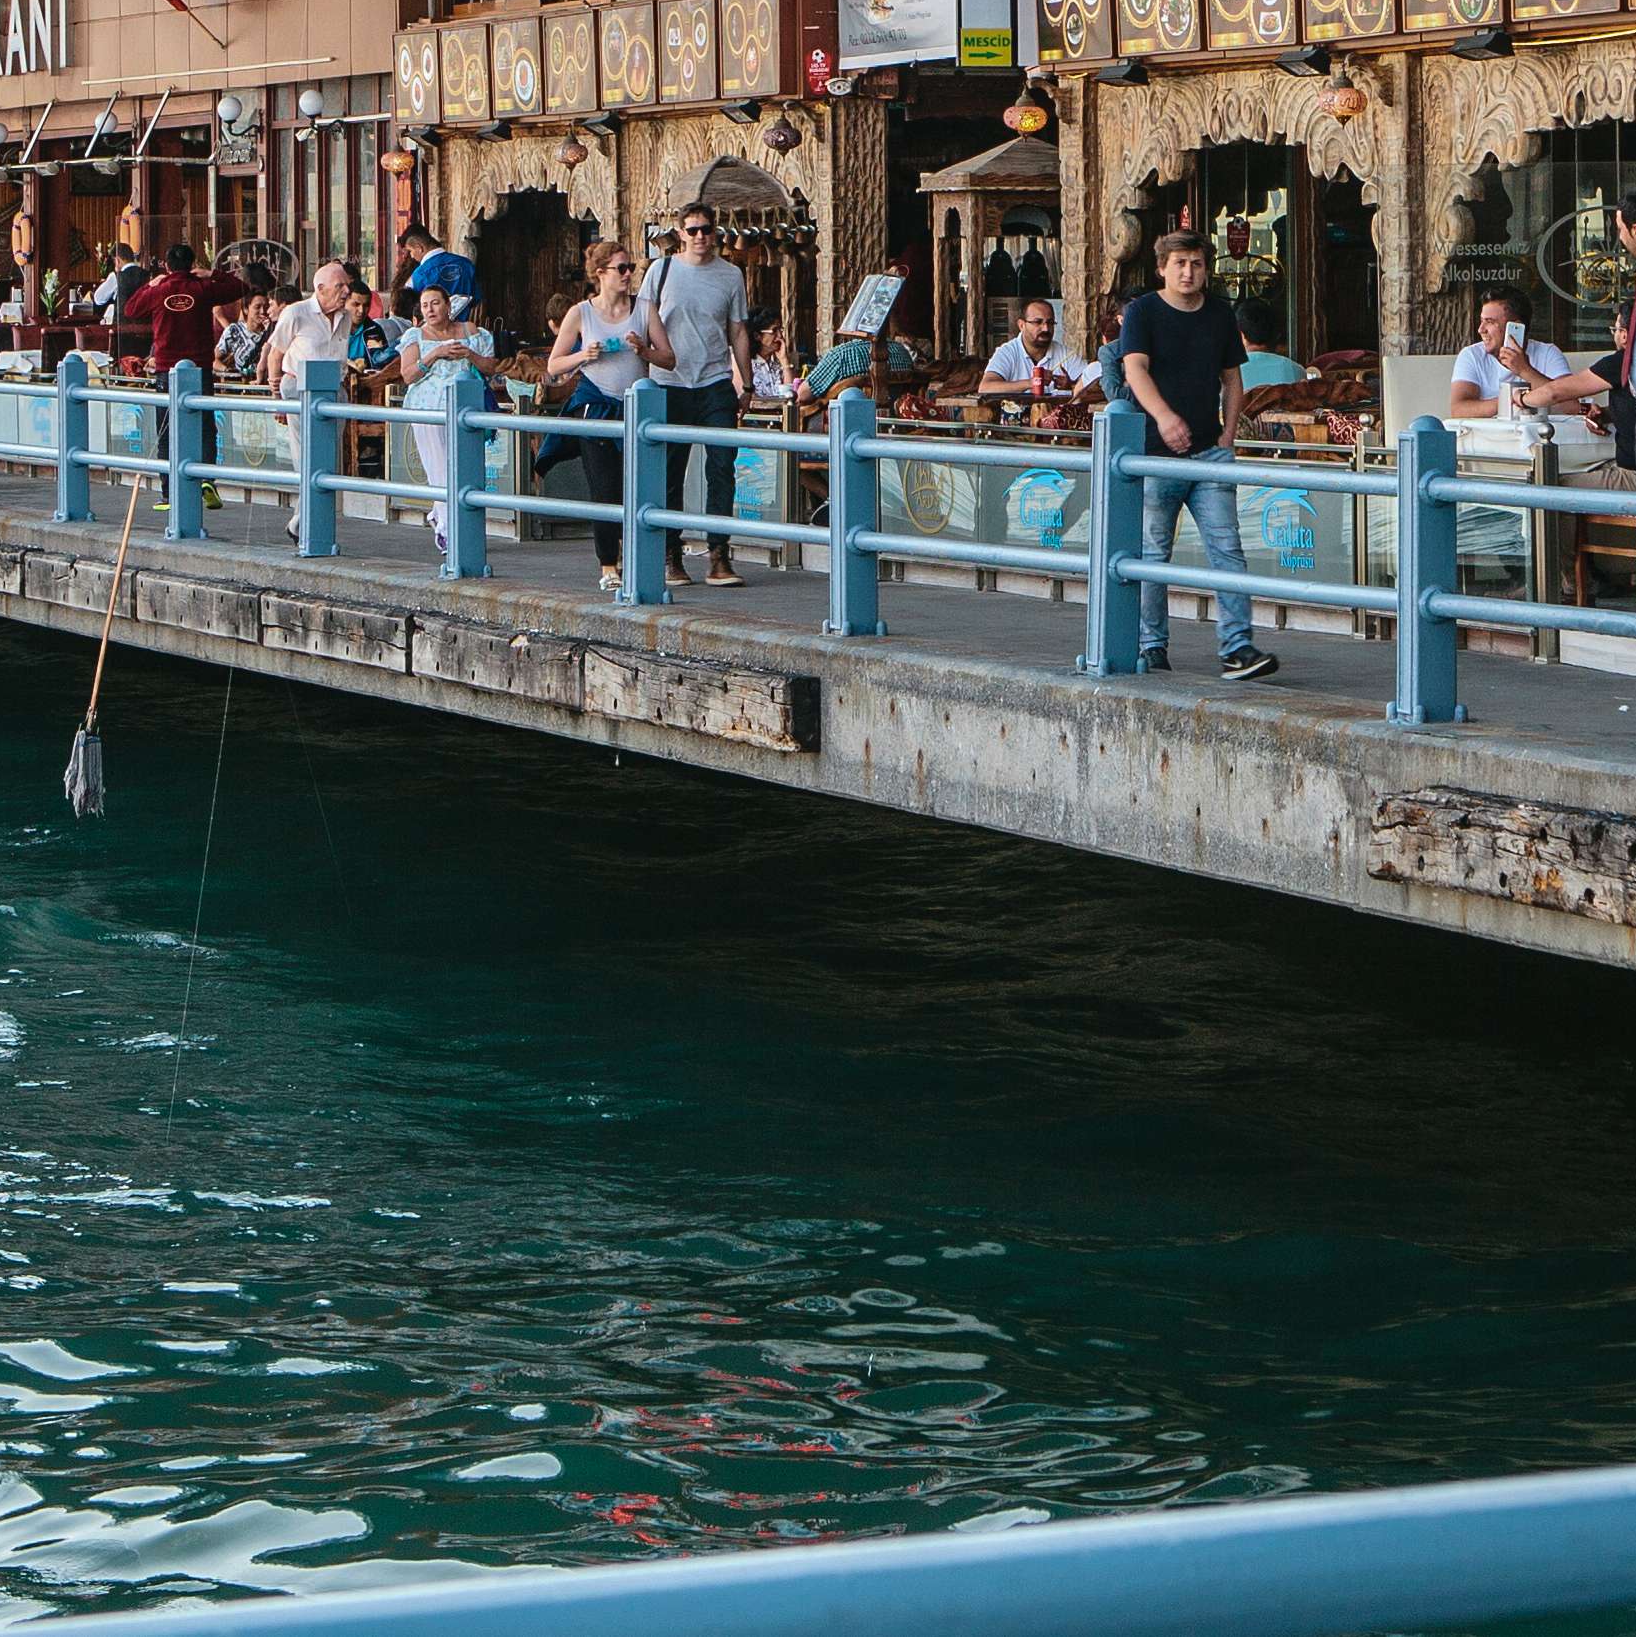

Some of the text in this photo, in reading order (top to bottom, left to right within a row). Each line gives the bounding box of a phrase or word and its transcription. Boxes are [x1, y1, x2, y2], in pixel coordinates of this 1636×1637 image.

[964, 34, 1010, 47] MESCİD
[1441, 264, 1523, 282] Alkolsuzdur
[1261, 505, 1314, 548] Galata
